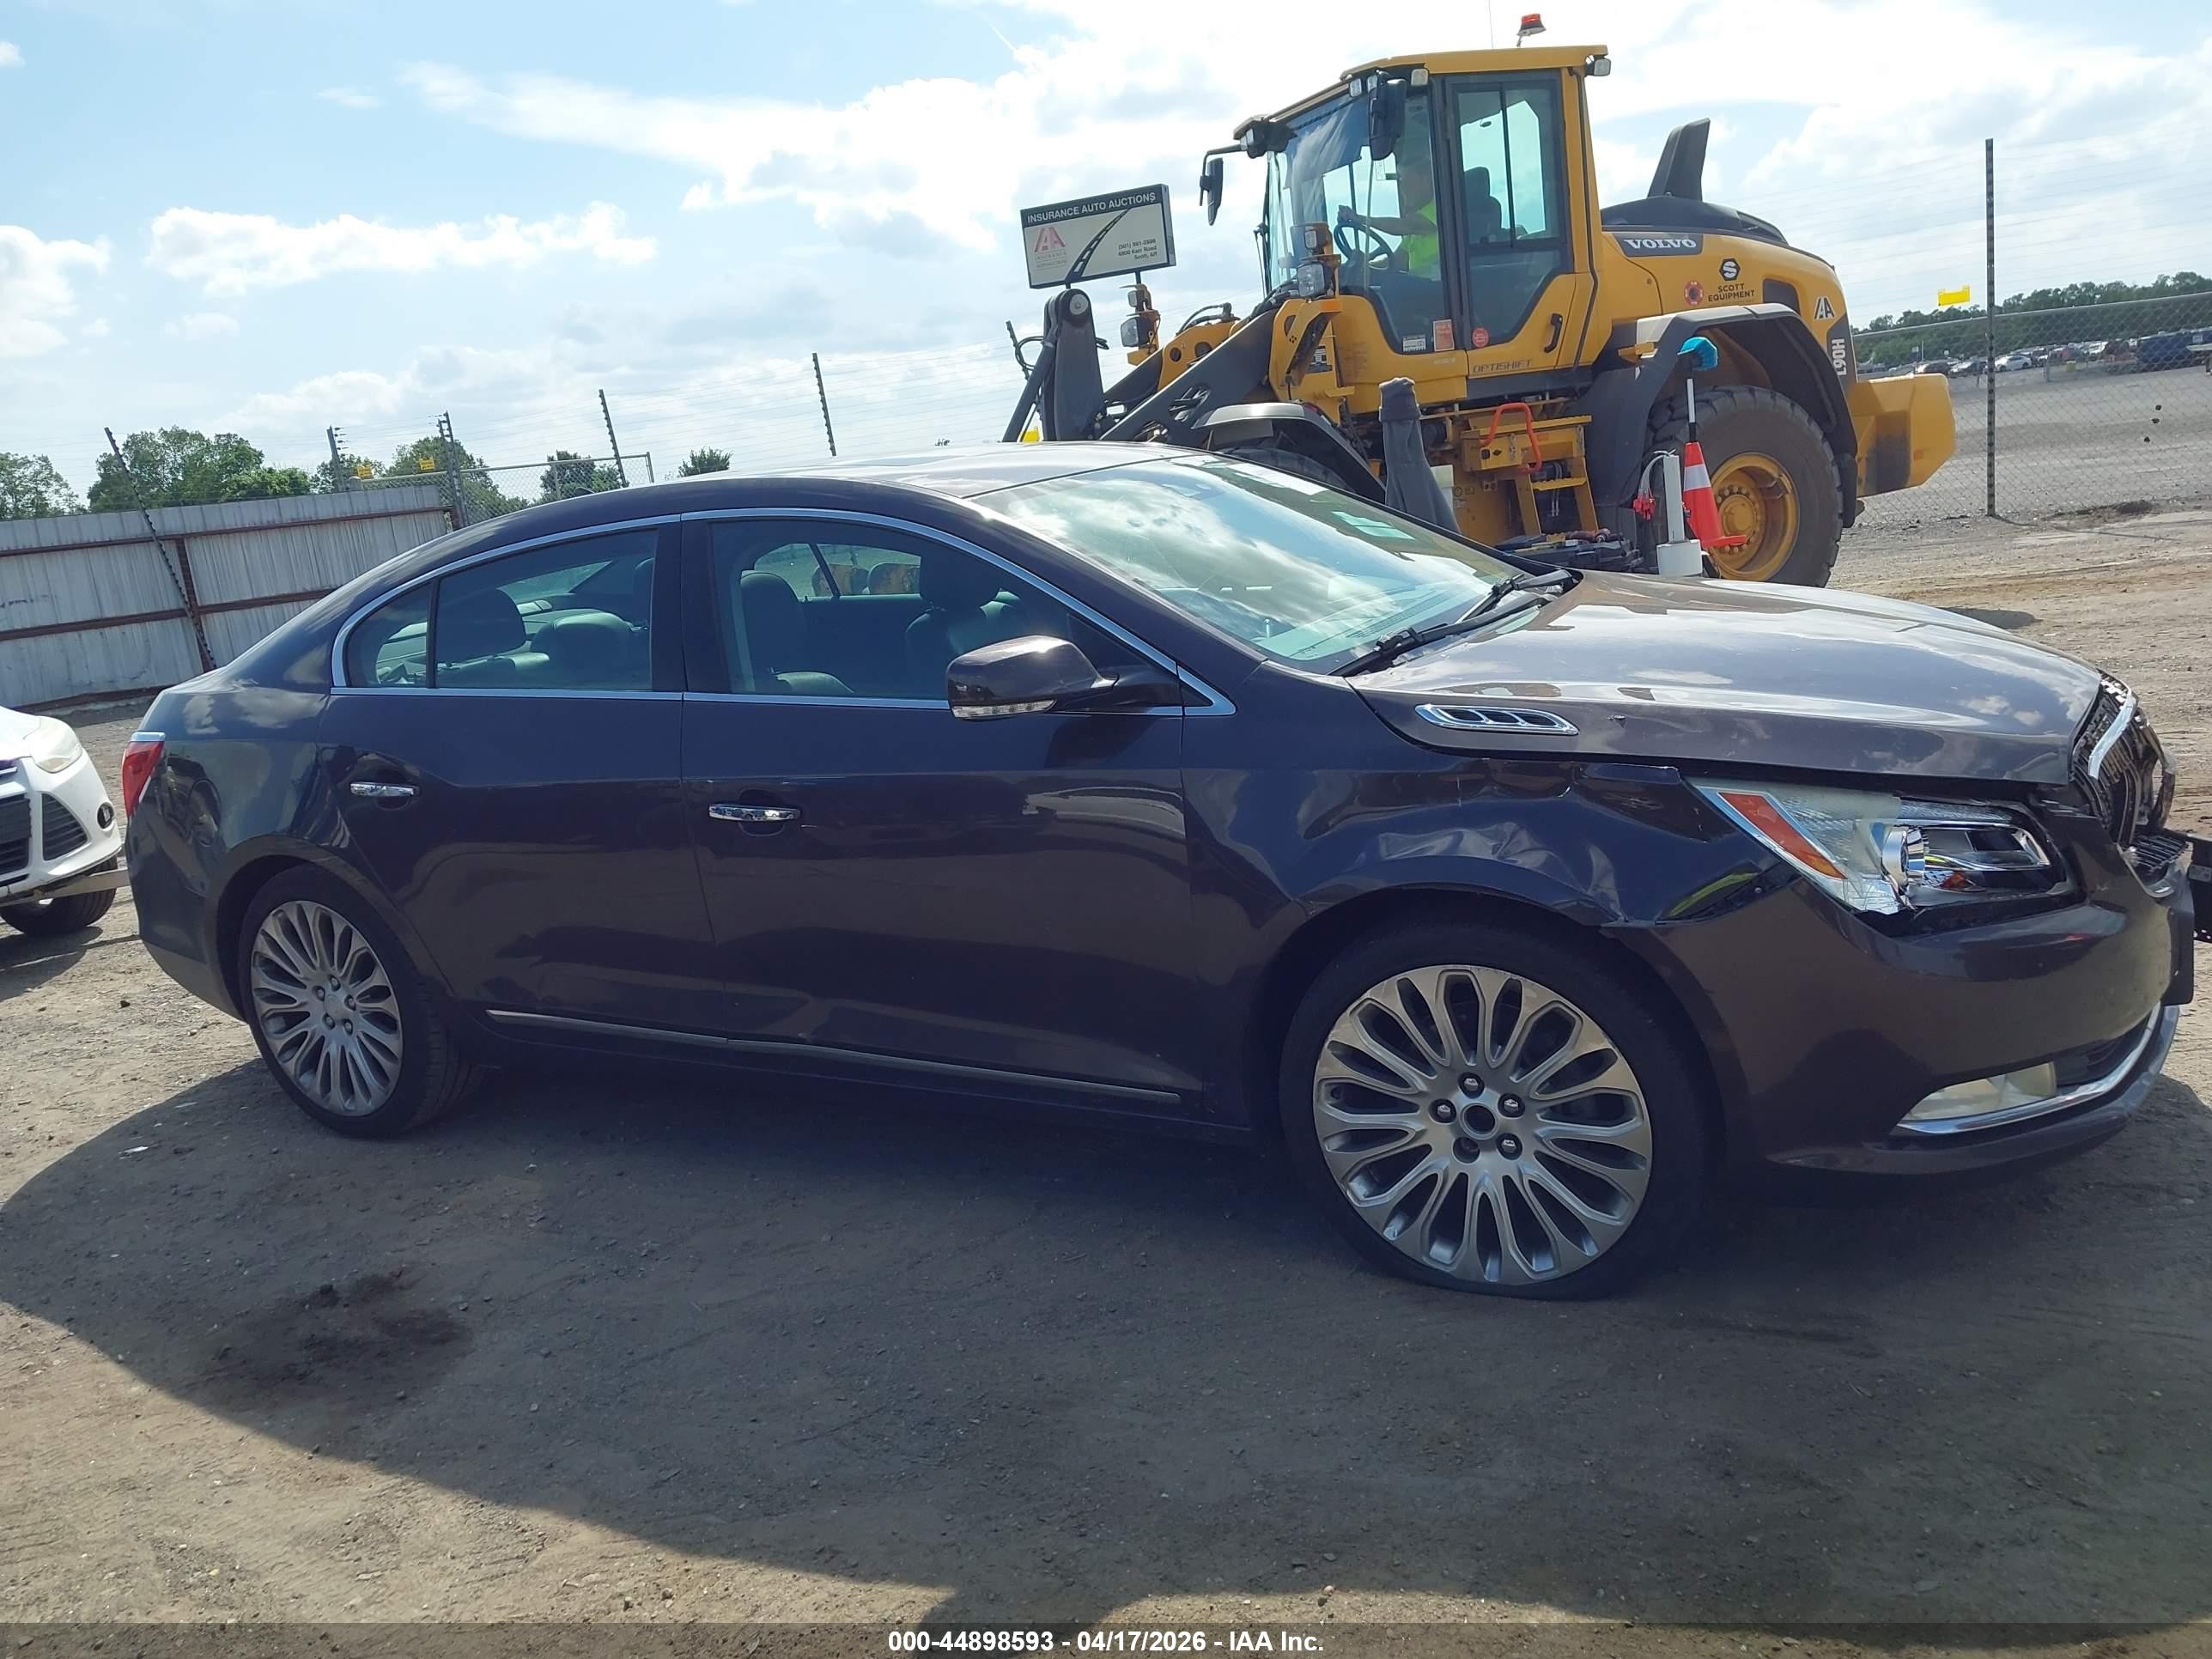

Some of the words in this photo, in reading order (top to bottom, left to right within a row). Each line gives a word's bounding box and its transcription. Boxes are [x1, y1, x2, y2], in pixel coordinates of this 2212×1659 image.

[1027, 206, 1079, 223] INSURANCE
[1081, 201, 1107, 214] AUTO
[1109, 191, 1156, 209] AUCTIONS
[1623, 239, 1697, 249] VOLVO
[1717, 283, 1745, 293] SCOTT
[1708, 289, 1755, 302] EQUIPMENT
[1832, 338, 1847, 376] L90H
[1473, 359, 1533, 373] OPTISHIFT
